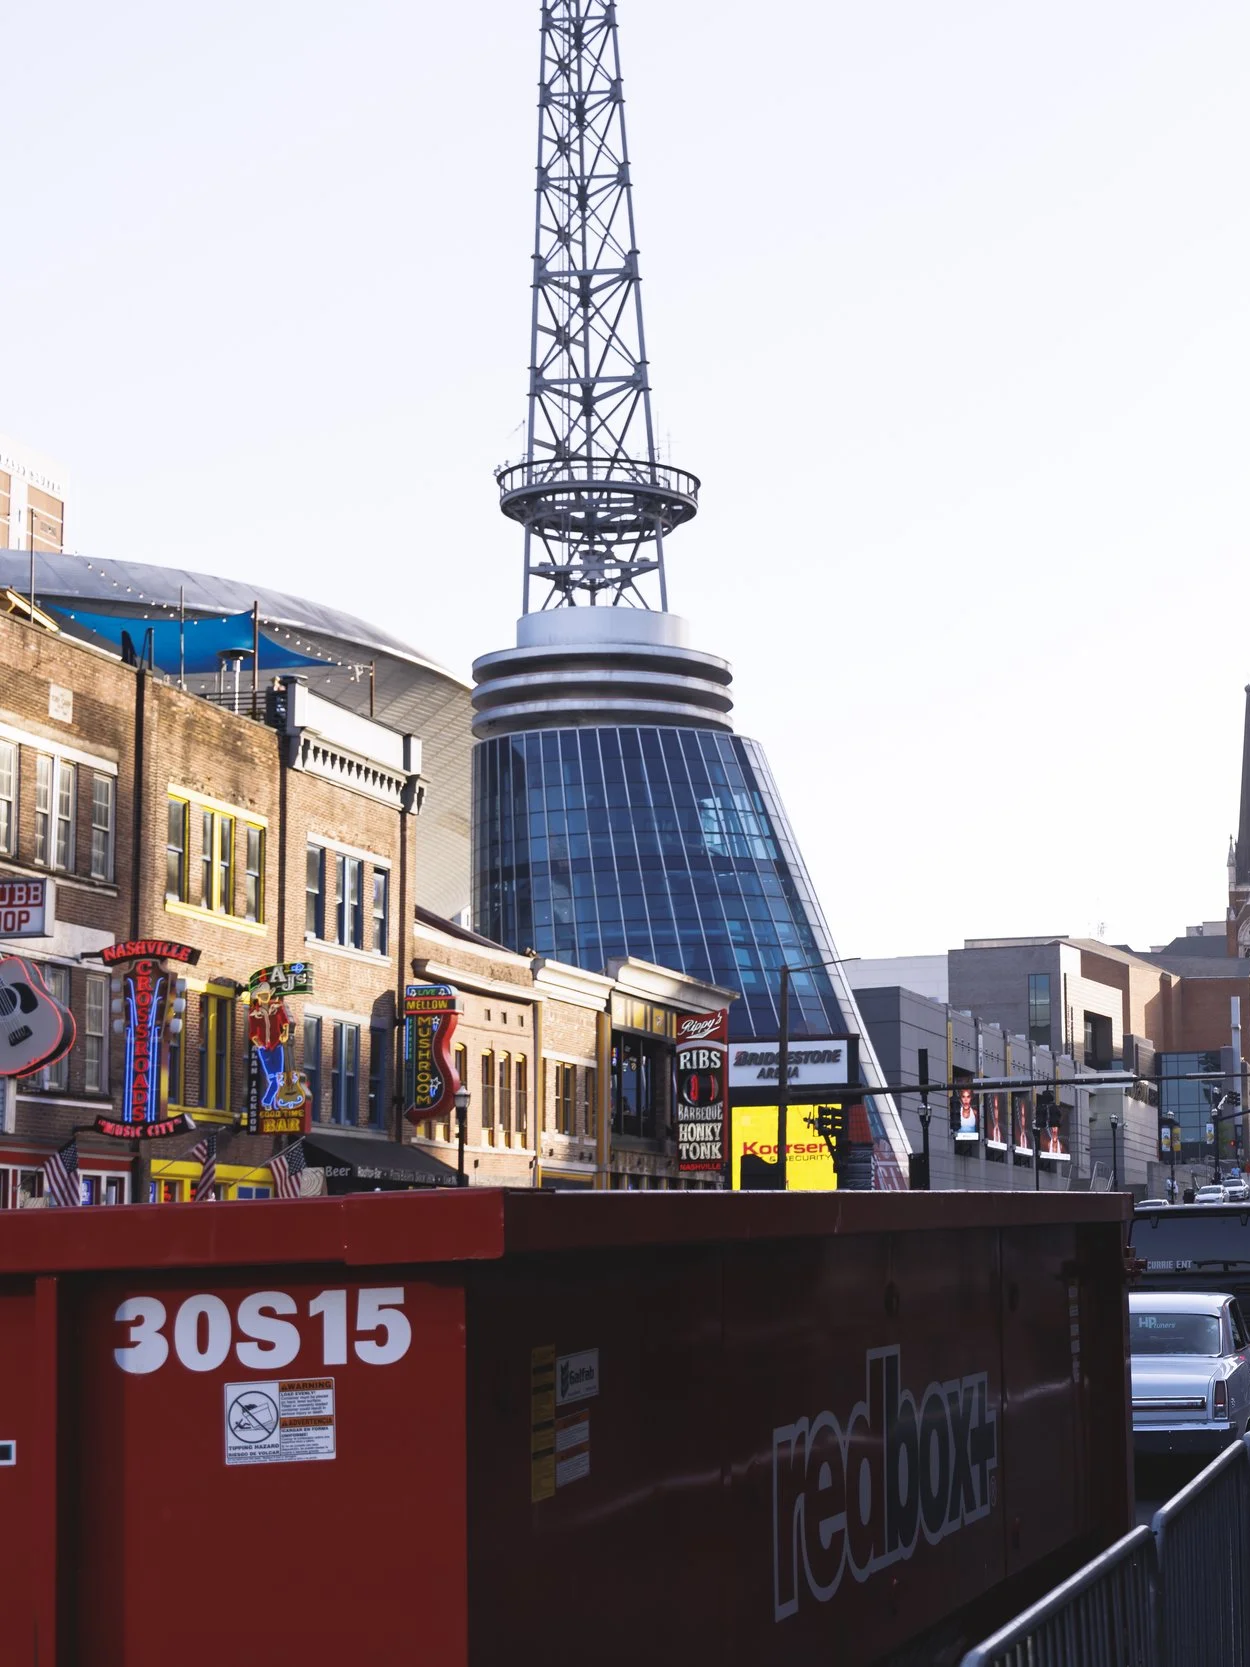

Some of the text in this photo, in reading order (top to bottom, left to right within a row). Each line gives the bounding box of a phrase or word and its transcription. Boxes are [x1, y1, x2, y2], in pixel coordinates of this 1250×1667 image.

[0, 910, 31, 932] OP
[102, 941, 191, 962] NASHVILLE
[406, 999, 449, 1010] MELLOW
[678, 1013, 722, 1037] Rippy's
[132, 961, 152, 1122] CROSSROADS
[416, 1017, 432, 1105] MUSHROOM
[679, 1050, 722, 1070] RIBS
[733, 1049, 842, 1067] BRIDESTONE
[678, 1102, 723, 1121] BARBEQUE
[263, 1118, 301, 1133] BAR
[679, 1124, 722, 1142] HONKY
[679, 1142, 722, 1161] TONK
[325, 1166, 351, 1178] Beer
[679, 1163, 722, 1171] NASHVILLE
[113, 1286, 412, 1374] 30S15
[287, 1381, 332, 1390] WARNING
